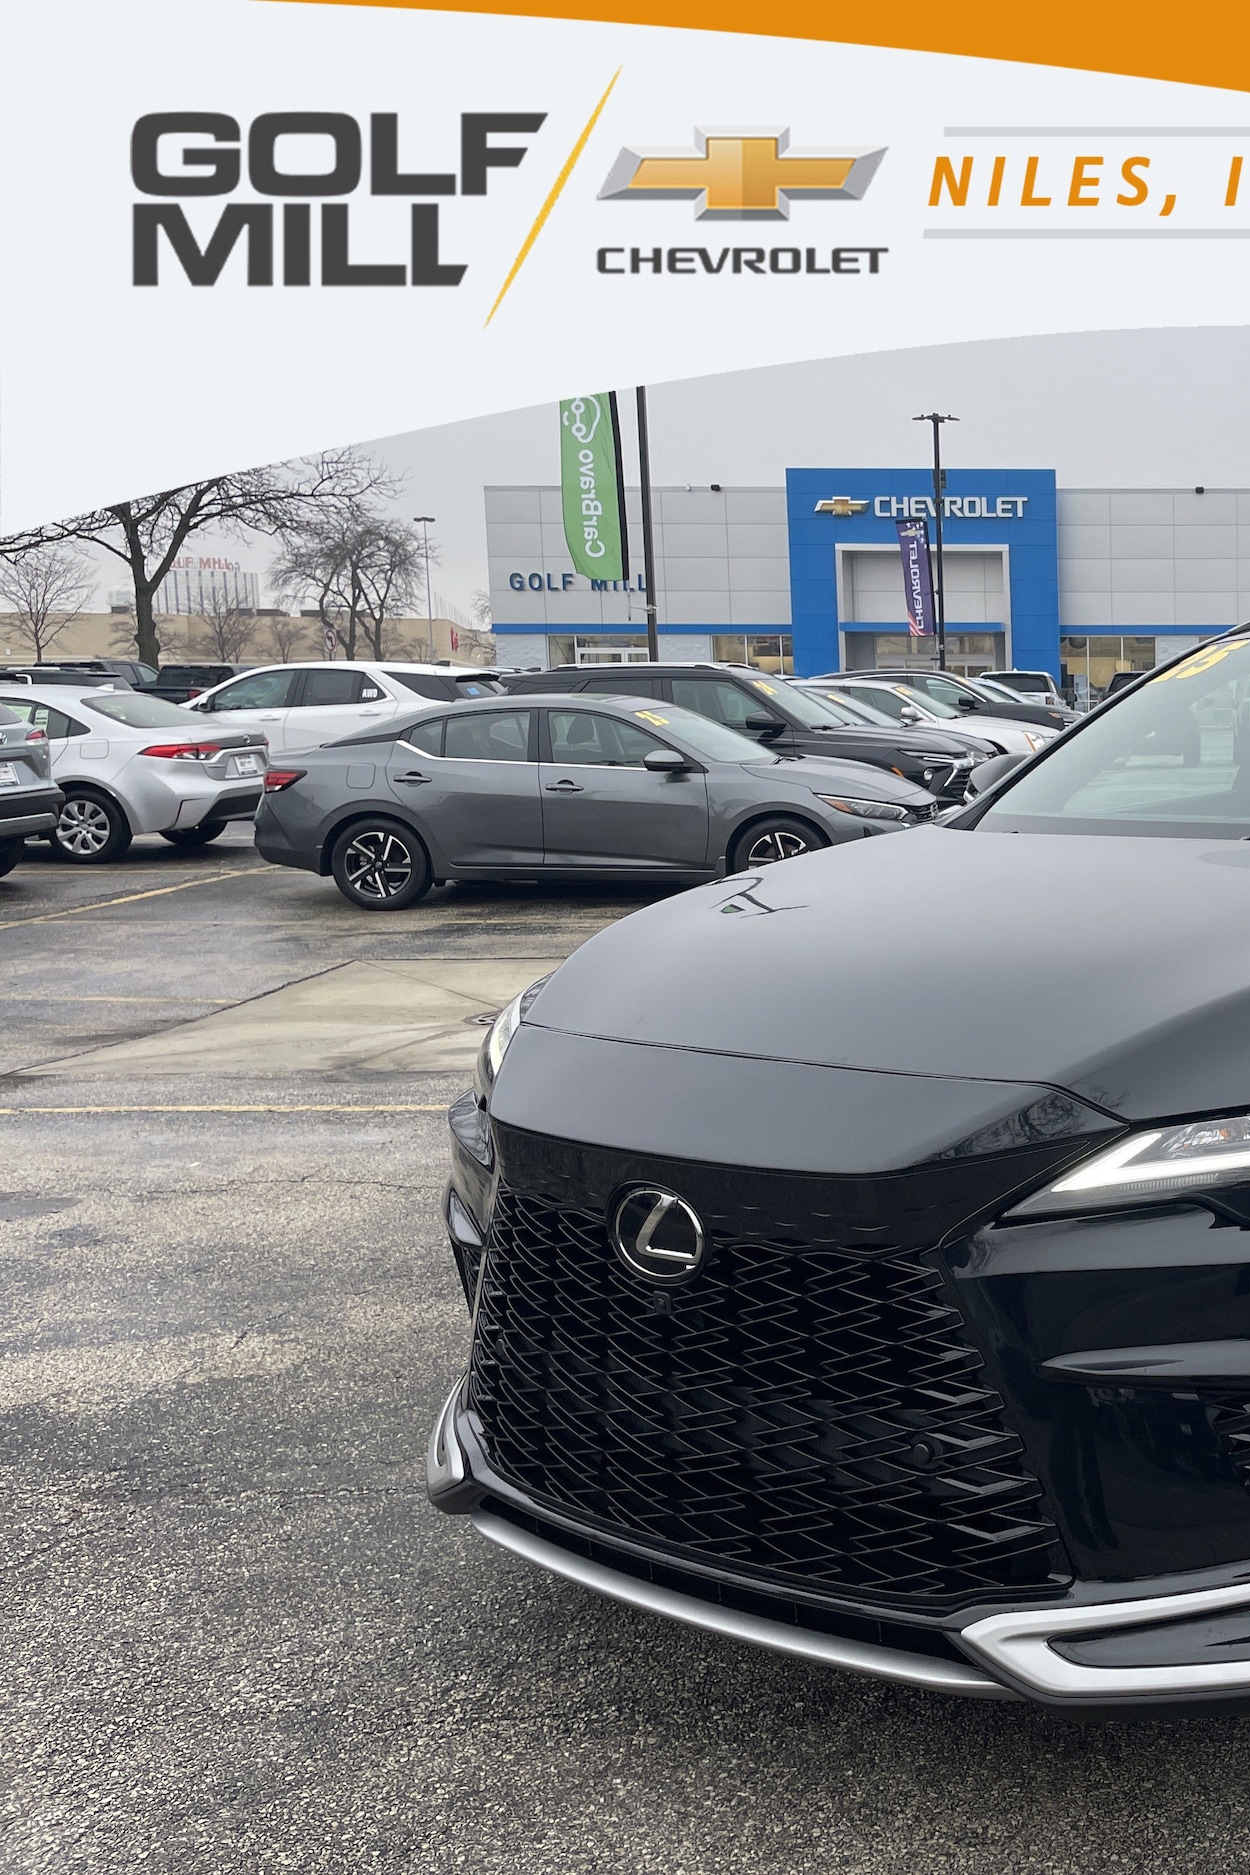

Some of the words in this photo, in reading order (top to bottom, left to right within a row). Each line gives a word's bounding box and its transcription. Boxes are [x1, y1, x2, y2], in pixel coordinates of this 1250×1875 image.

[874, 496, 1028, 518] CHEVROLET
[509, 573, 575, 591] GOLF
[361, 688, 379, 698] AWD
